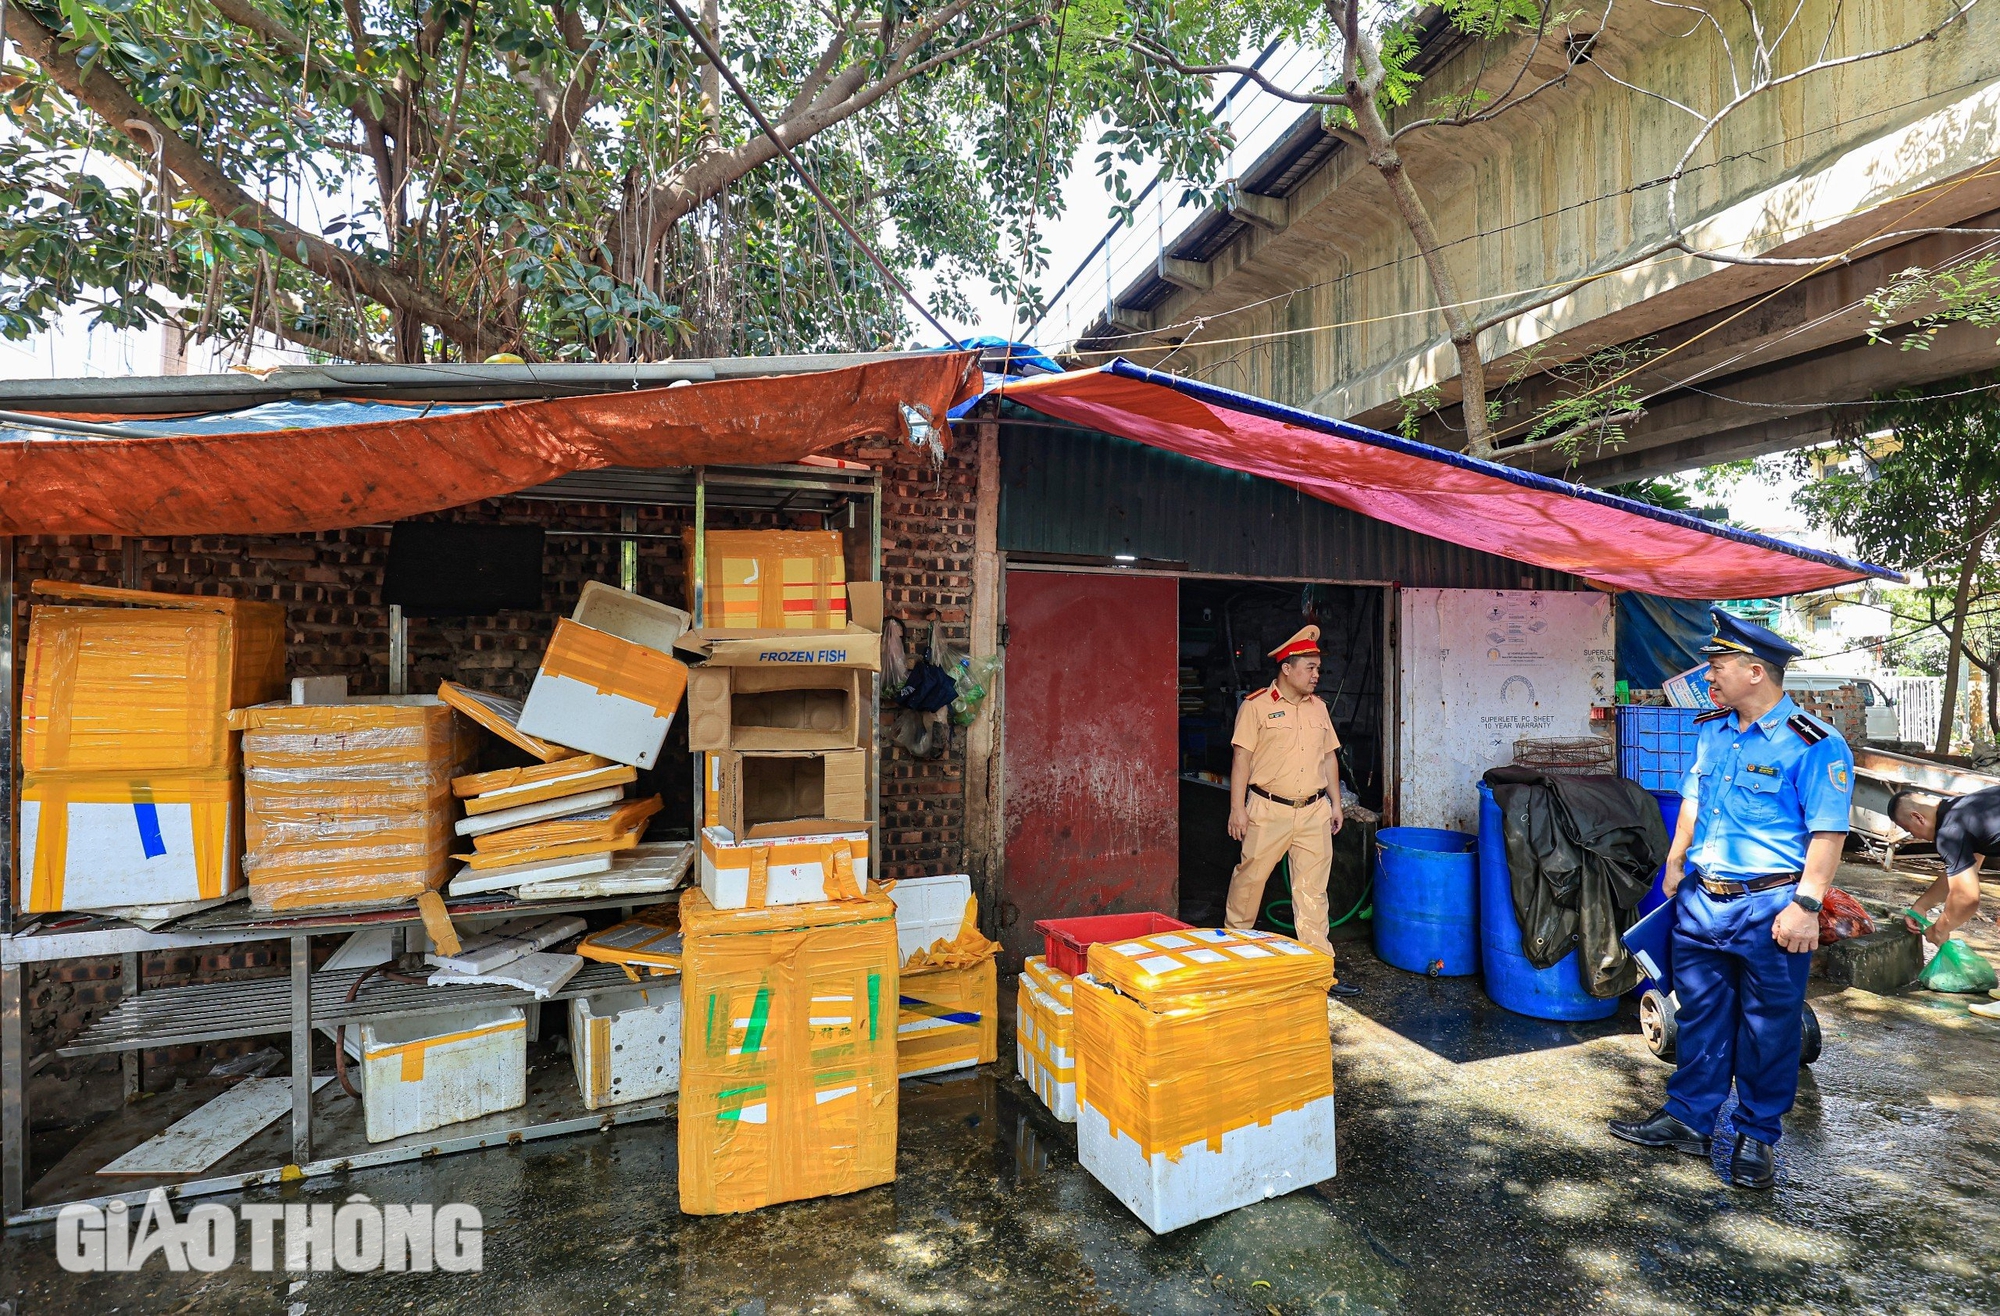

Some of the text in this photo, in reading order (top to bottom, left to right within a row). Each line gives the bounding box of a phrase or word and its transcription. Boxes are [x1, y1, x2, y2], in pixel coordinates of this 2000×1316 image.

[758, 649, 846, 662] FROZEN FISH
[1690, 681, 1706, 704] WATER
[1480, 715, 1518, 723] SUPERLETE
